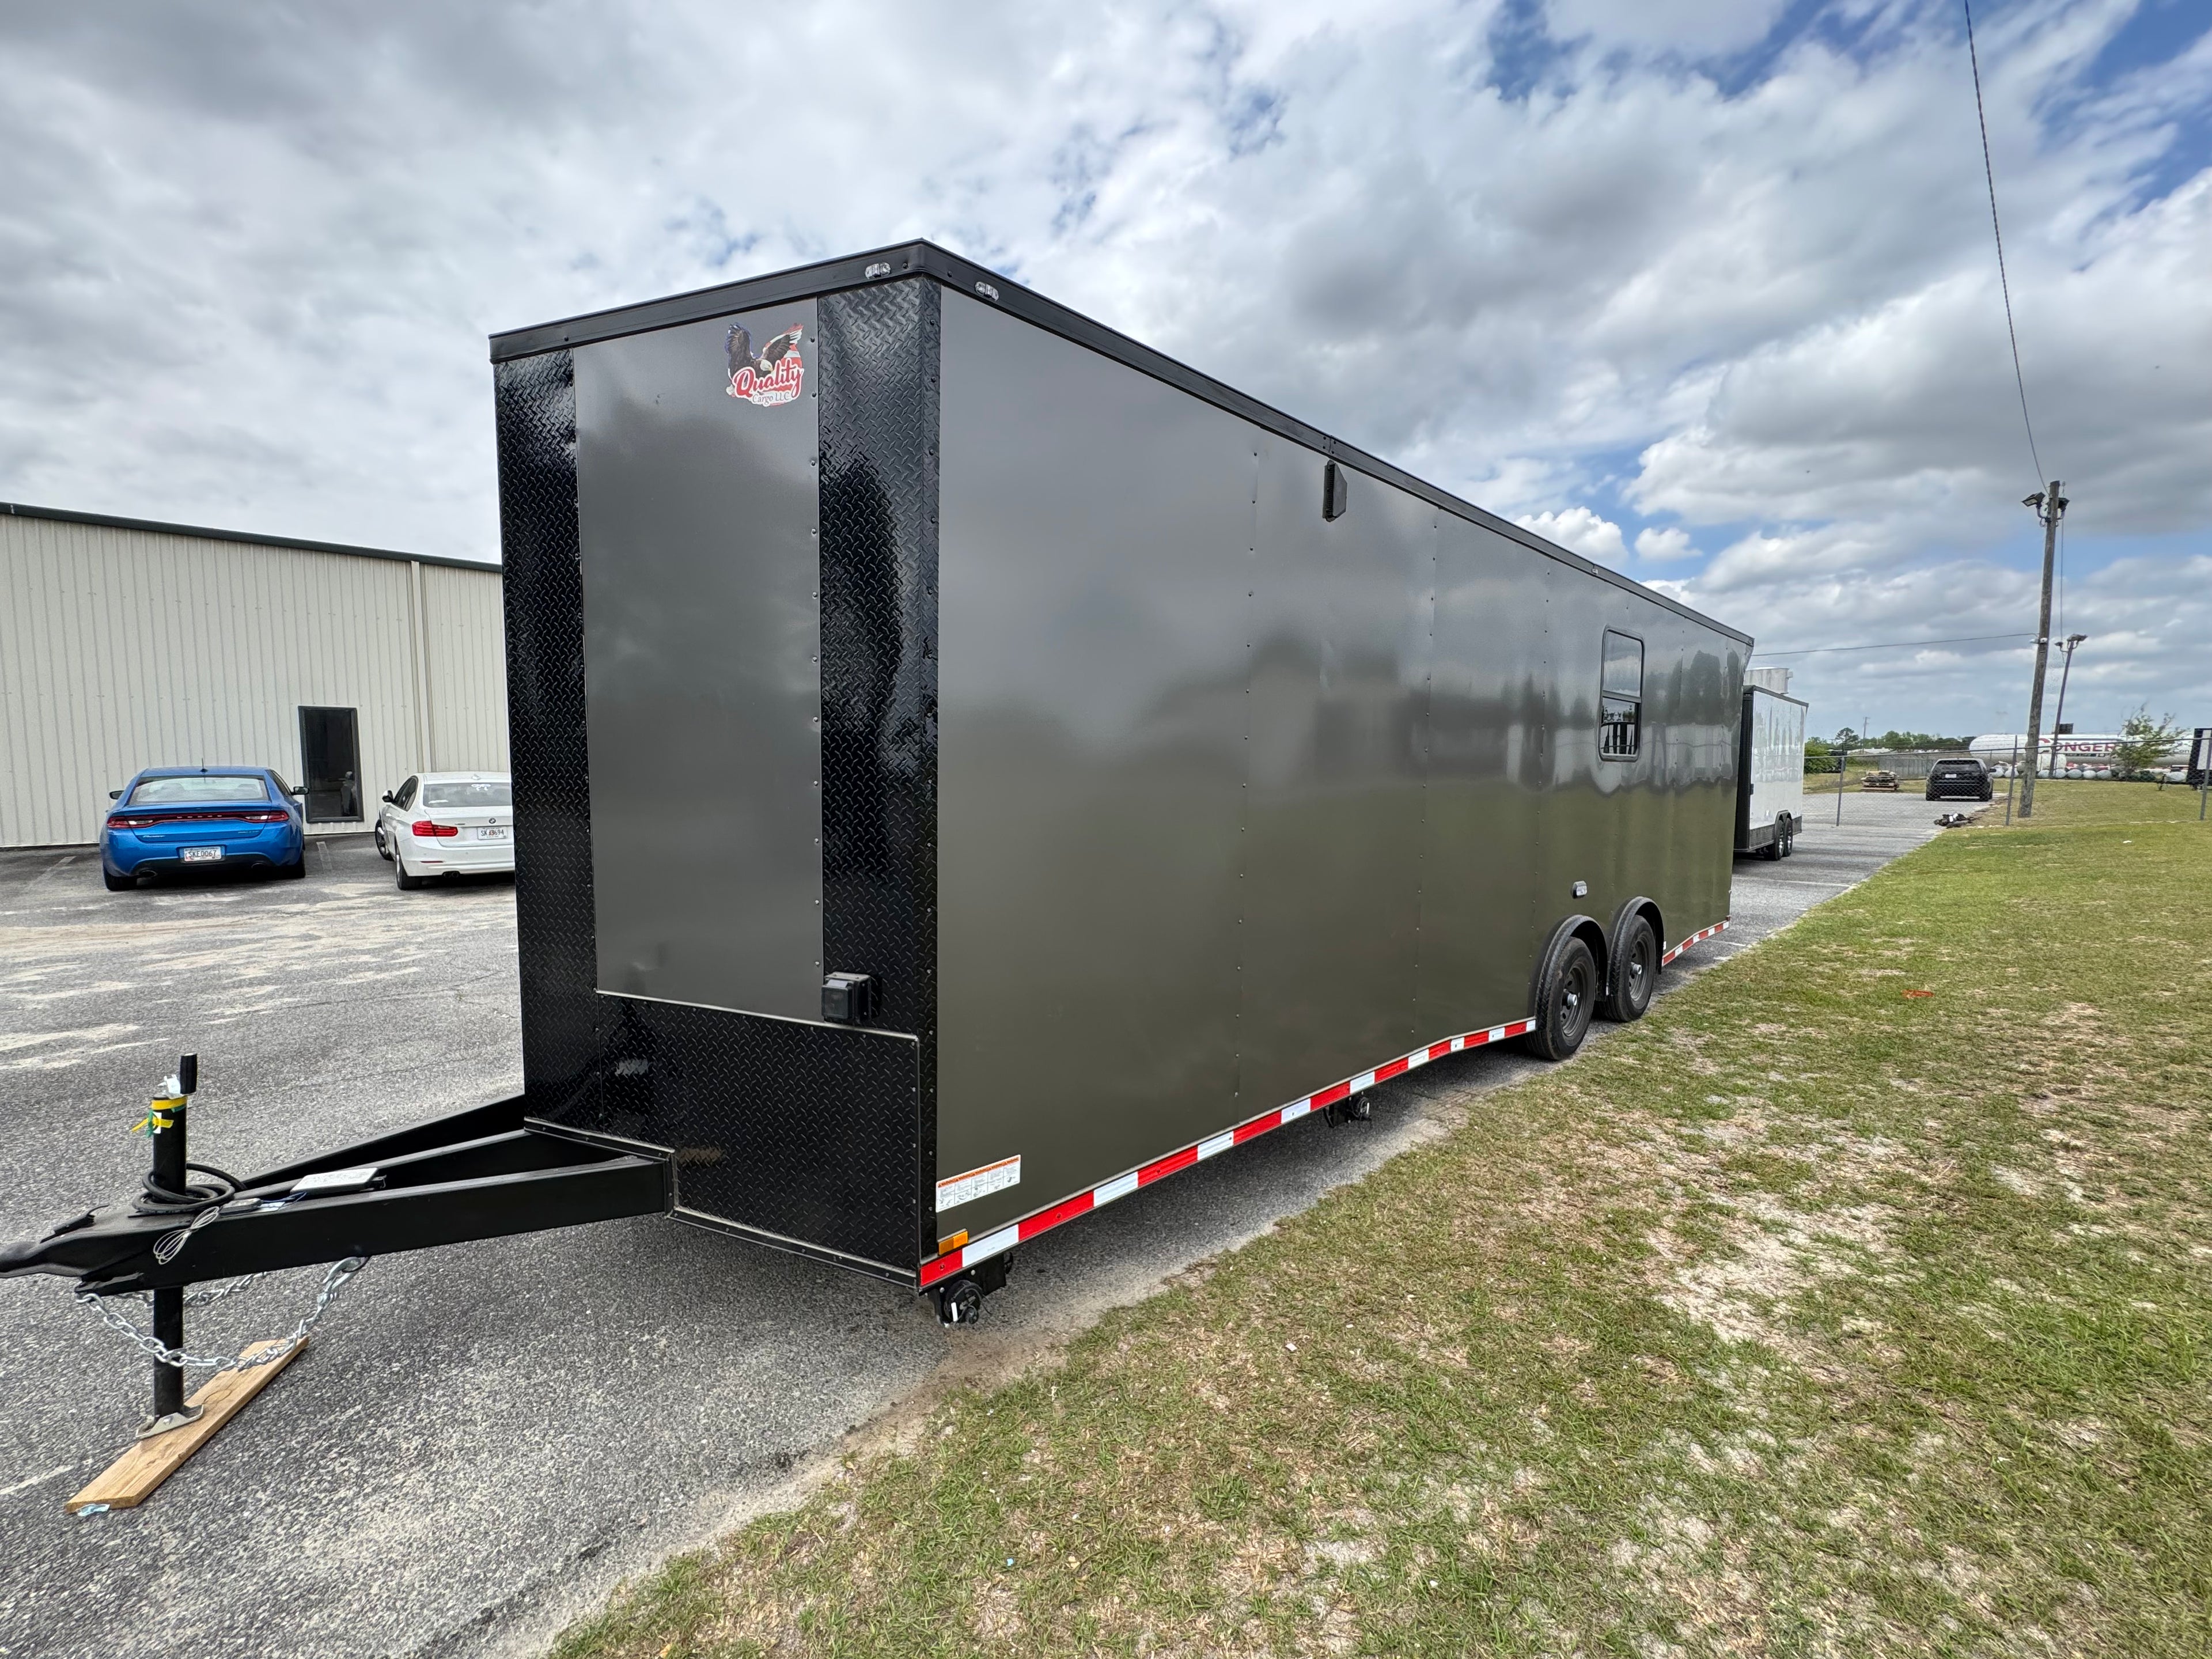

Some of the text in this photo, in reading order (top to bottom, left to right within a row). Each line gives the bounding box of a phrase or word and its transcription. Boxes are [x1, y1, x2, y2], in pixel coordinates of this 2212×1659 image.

[733, 358, 803, 397] Quality
[752, 391, 789, 404] Cargo LLC
